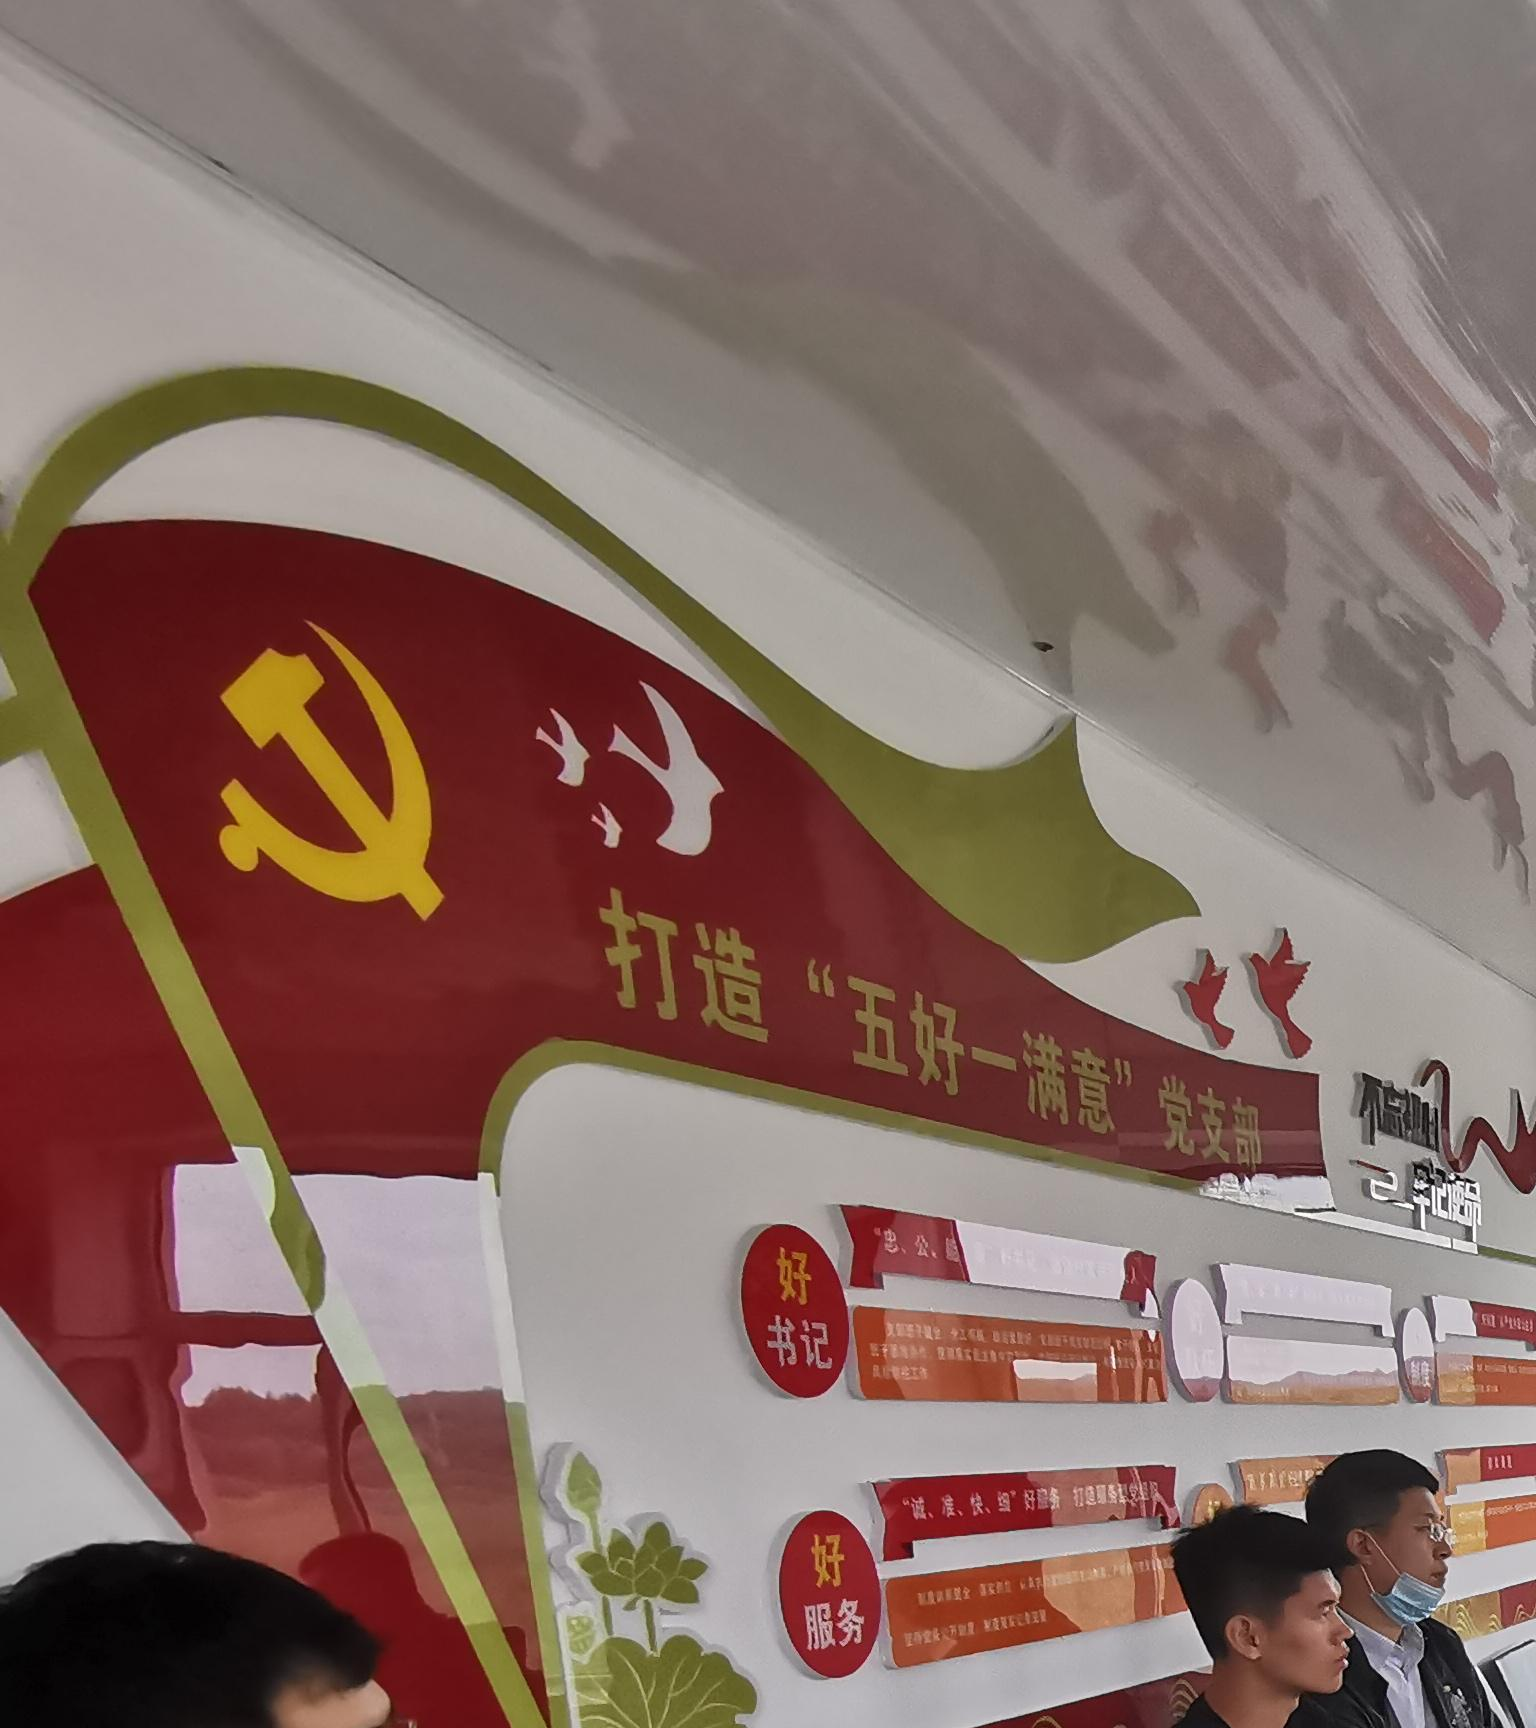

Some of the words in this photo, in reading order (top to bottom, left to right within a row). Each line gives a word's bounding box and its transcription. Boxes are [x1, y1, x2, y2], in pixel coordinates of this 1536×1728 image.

[776, 1245, 812, 1305] 好
[767, 1314, 833, 1370] 书记
[811, 1533, 845, 1588] 好
[804, 1598, 866, 1652] 服务
